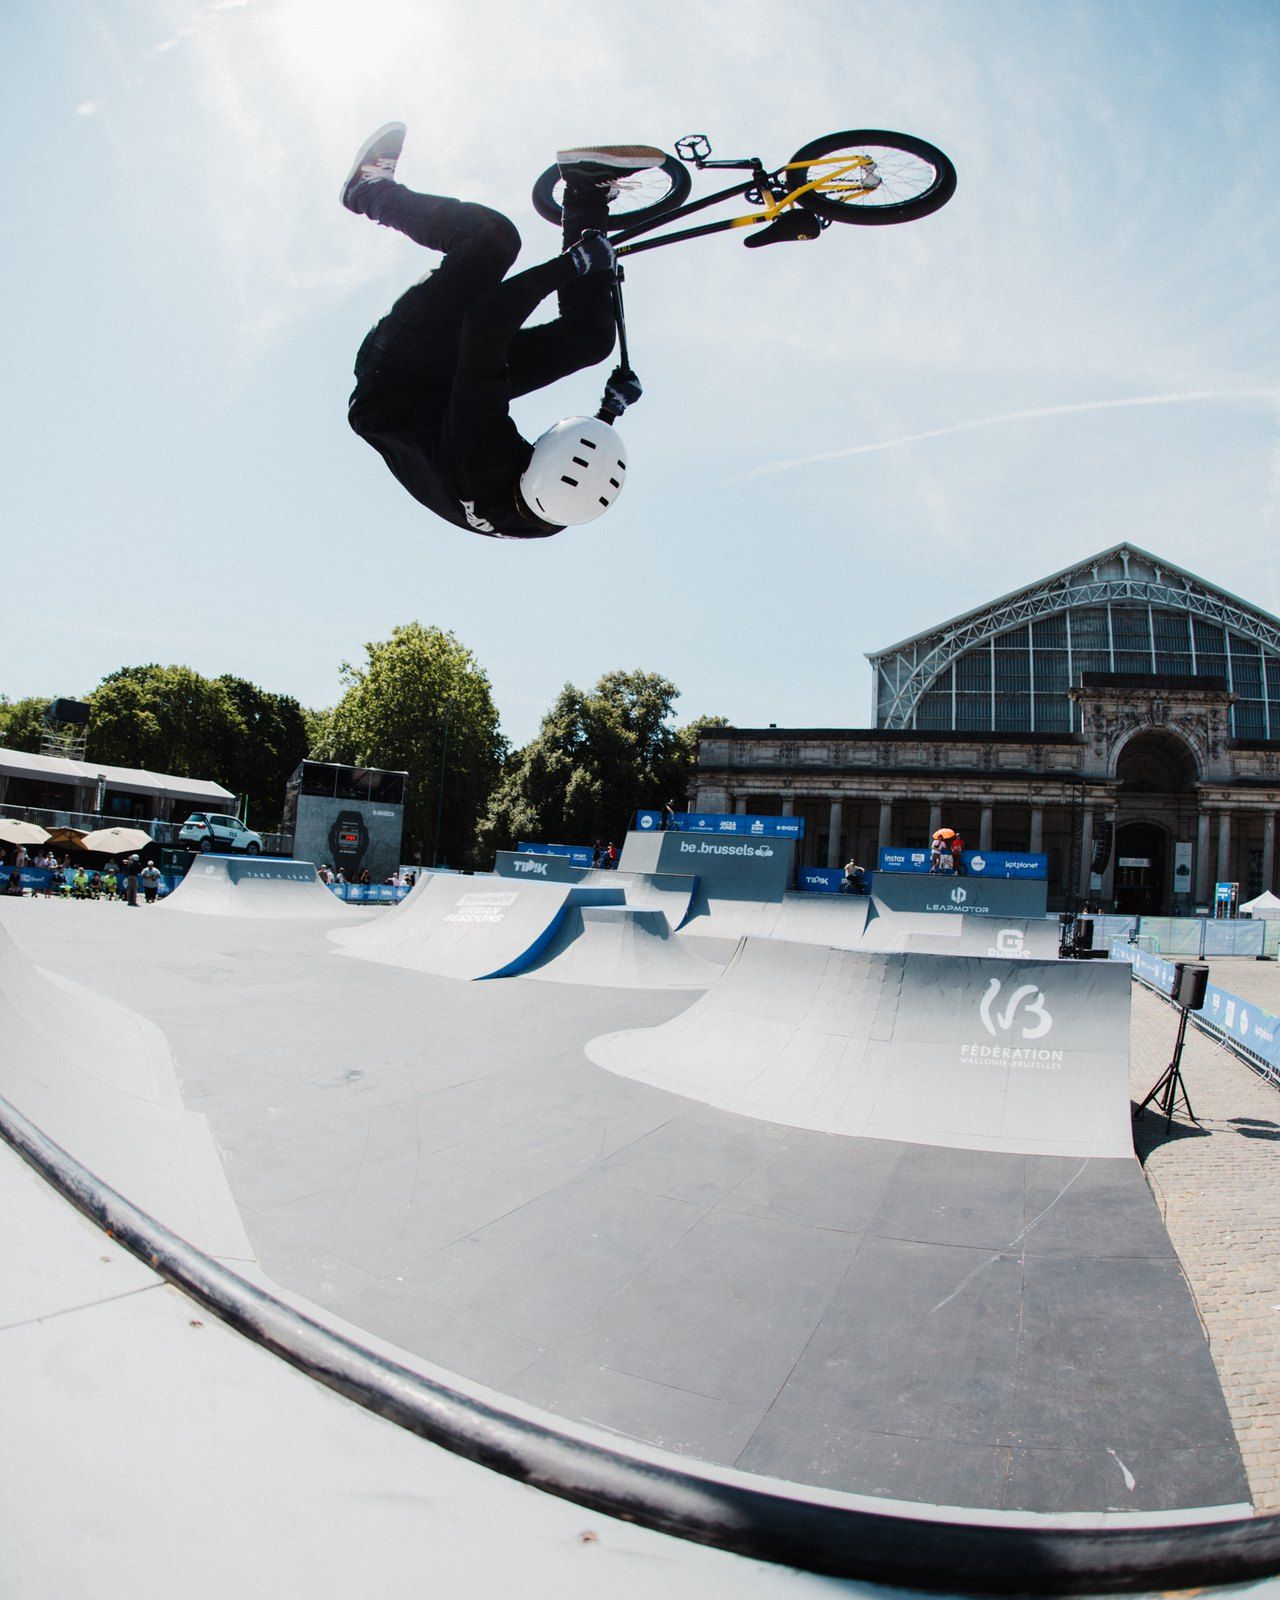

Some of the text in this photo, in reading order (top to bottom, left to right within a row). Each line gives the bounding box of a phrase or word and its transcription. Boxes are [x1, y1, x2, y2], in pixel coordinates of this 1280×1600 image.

[884, 853, 906, 863] instax
[926, 904, 989, 913] LEAPMOTOR
[960, 1043, 1064, 1061] FÉDÉRATION
